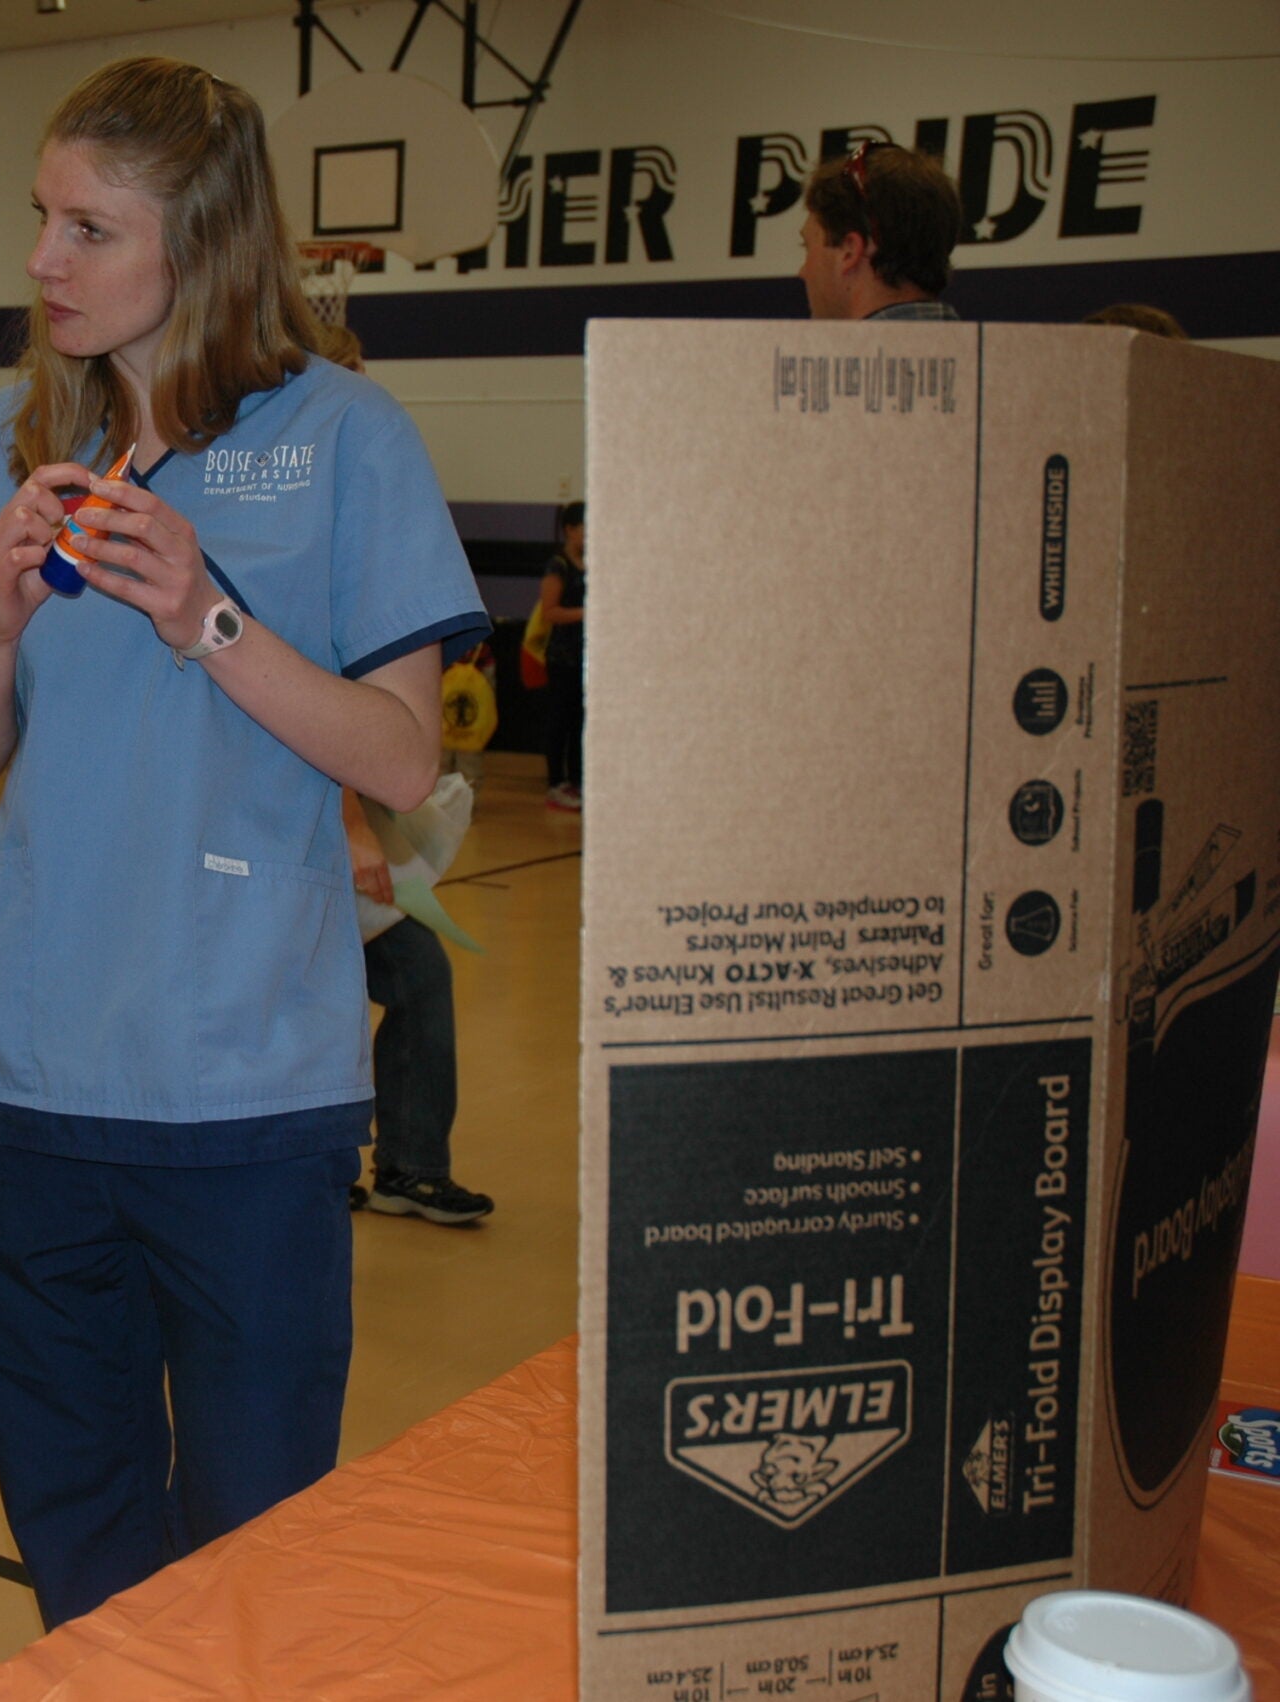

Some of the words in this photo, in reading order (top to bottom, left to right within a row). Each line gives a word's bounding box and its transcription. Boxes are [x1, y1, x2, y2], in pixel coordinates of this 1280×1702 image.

[730, 93, 1157, 258] PDE
[205, 449, 254, 473] BOISE
[272, 444, 316, 468] STATE
[204, 466, 312, 484] UNIVERSITY
[204, 483, 257, 495] DEPARTMENT
[261, 481, 274, 491] OF
[277, 479, 311, 492] NURSING
[1046, 467, 1066, 538] INSIDE
[1044, 542, 1063, 609] WHITE
[658, 901, 749, 927] Project.
[754, 901, 809, 924] Your
[814, 895, 919, 921] Complete
[924, 895, 945, 916] to
[686, 931, 785, 955] Markers
[791, 930, 845, 951] Paint
[858, 924, 945, 946] Painters
[978, 924, 994, 971] Great
[607, 965, 628, 988] &
[634, 963, 714, 986] Knives
[825, 952, 943, 977] Adhesives,
[700, 992, 741, 1014] Use
[749, 988, 836, 1013] Results!
[842, 984, 902, 1005] Great
[909, 981, 943, 1003] Get
[605, 993, 694, 1017] Elmer's
[1035, 1074, 1070, 1198] Board
[773, 1148, 866, 1175] Standing
[868, 1147, 907, 1171] Self
[743, 1184, 823, 1209] surface
[826, 1178, 906, 1204] Smooth
[715, 1214, 835, 1244] corrugated
[837, 1209, 904, 1234] Sturdy
[644, 1222, 713, 1249] board
[1132, 1197, 1195, 1300] Board
[1029, 1205, 1072, 1351] Display
[676, 1274, 915, 1354] Tri-Fold
[683, 1380, 895, 1439] ELMER'S
[1023, 1358, 1060, 1515] Tri-Fold
[1227, 1414, 1280, 1469] Sports
[990, 1418, 1010, 1510] ELMER'S
[838, 1649, 863, 1663] cm
[864, 1642, 899, 1660] 25.4
[676, 1666, 713, 1685] 25.4
[745, 1661, 771, 1675] cm
[774, 1654, 810, 1673] 50.8
[855, 1667, 872, 1681] 10
[647, 1672, 672, 1686] cm
[776, 1676, 797, 1694] 20
[693, 1687, 710, 1702] 10
